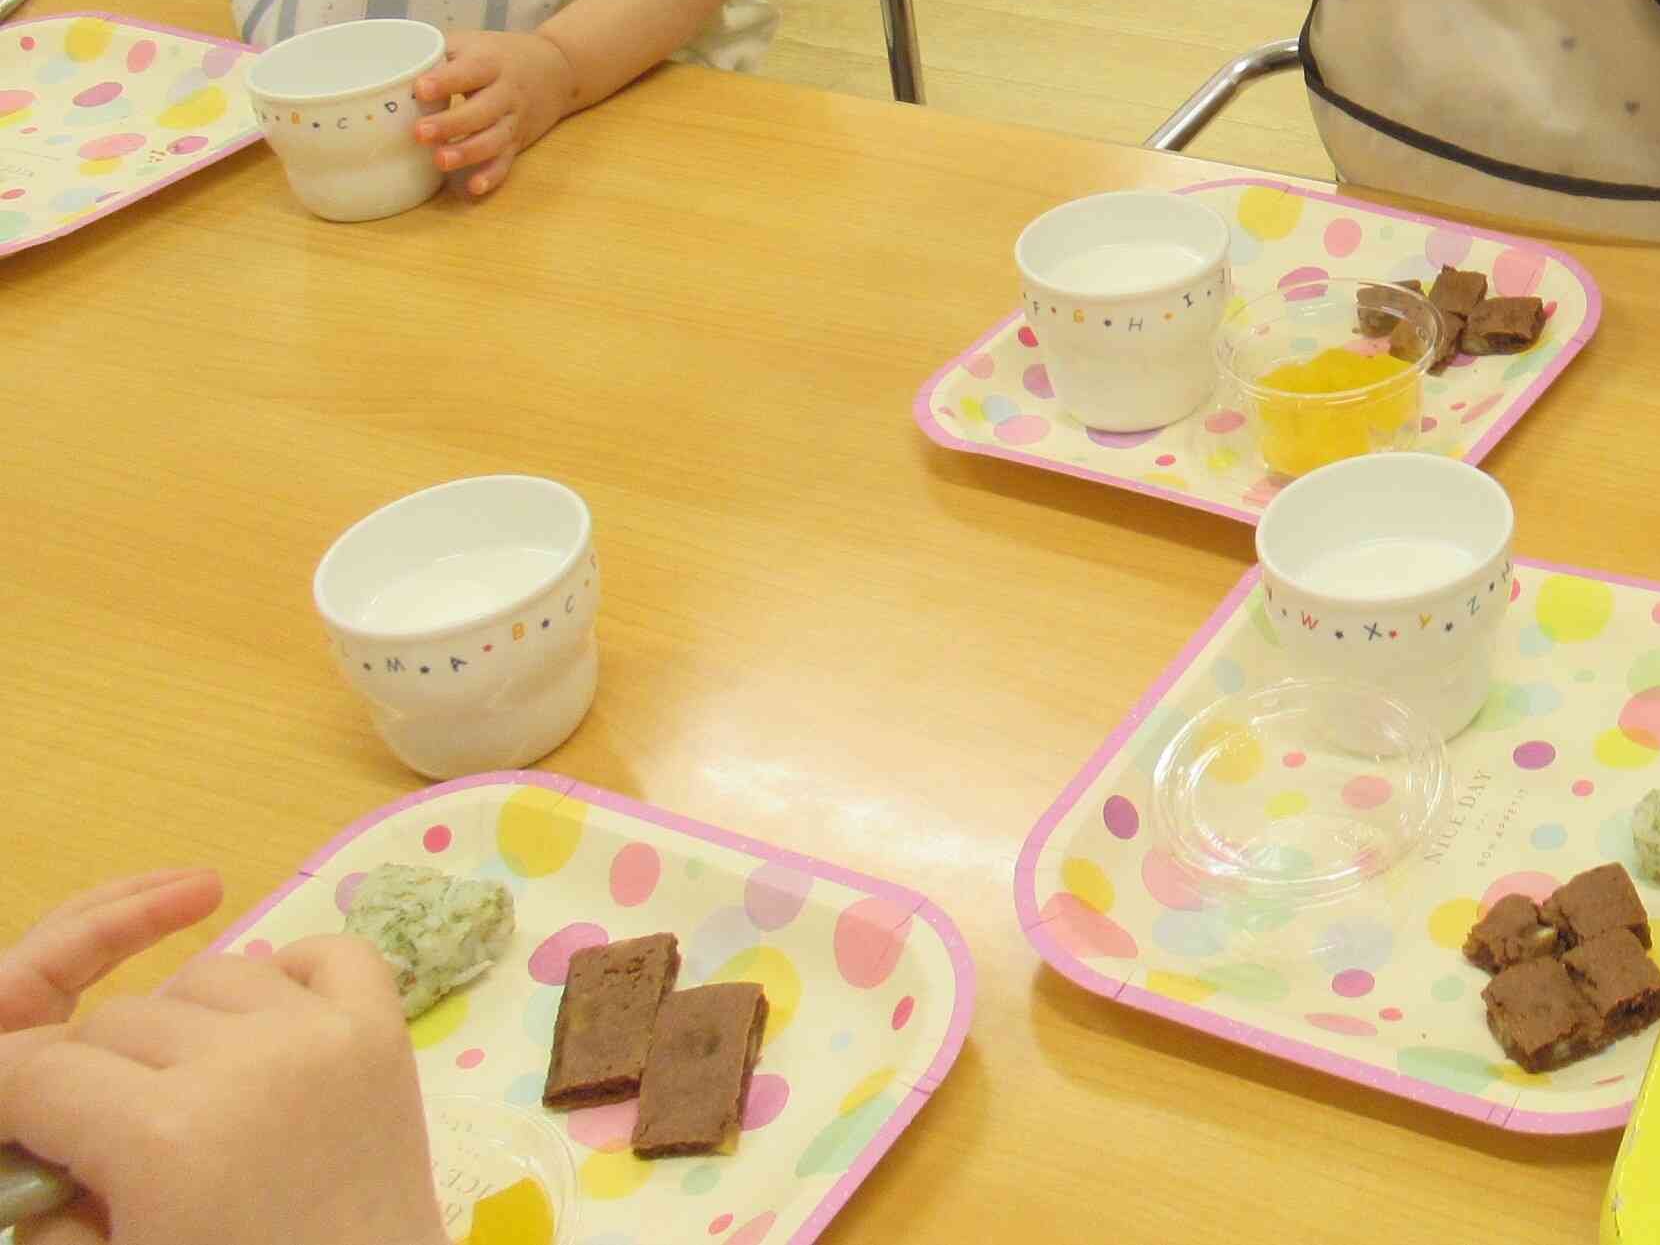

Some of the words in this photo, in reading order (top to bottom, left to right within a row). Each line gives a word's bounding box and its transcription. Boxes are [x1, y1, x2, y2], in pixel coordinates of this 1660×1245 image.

[1127, 317, 1144, 332] H
[1300, 610, 1320, 631] W
[1363, 621, 1384, 642] X
[1417, 611, 1433, 630] Y
[1456, 768, 1493, 809] DAY
